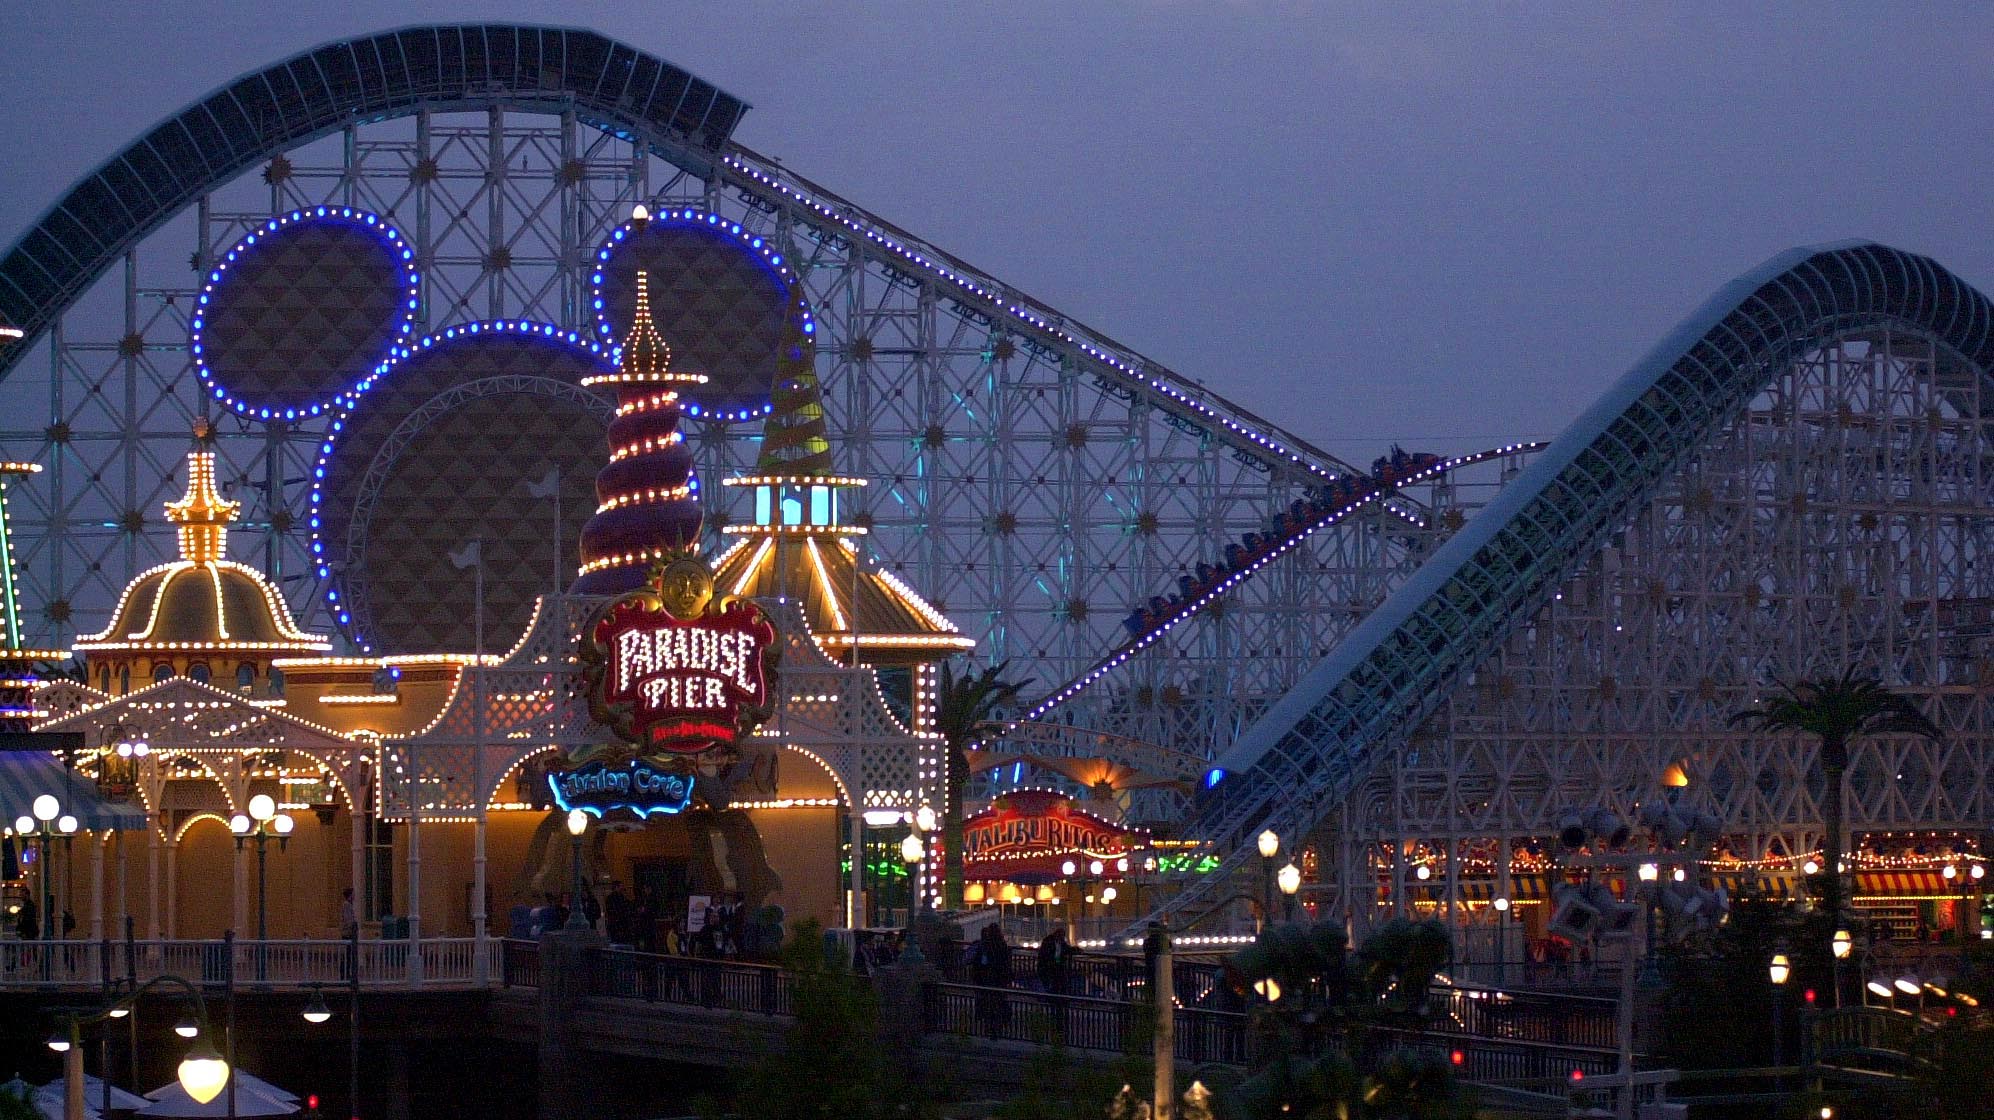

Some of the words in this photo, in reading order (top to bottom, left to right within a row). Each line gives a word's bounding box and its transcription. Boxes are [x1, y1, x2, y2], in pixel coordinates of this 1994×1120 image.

[619, 628, 757, 693] PARADISE
[644, 677, 727, 708] PIER
[634, 768, 685, 799] Cove
